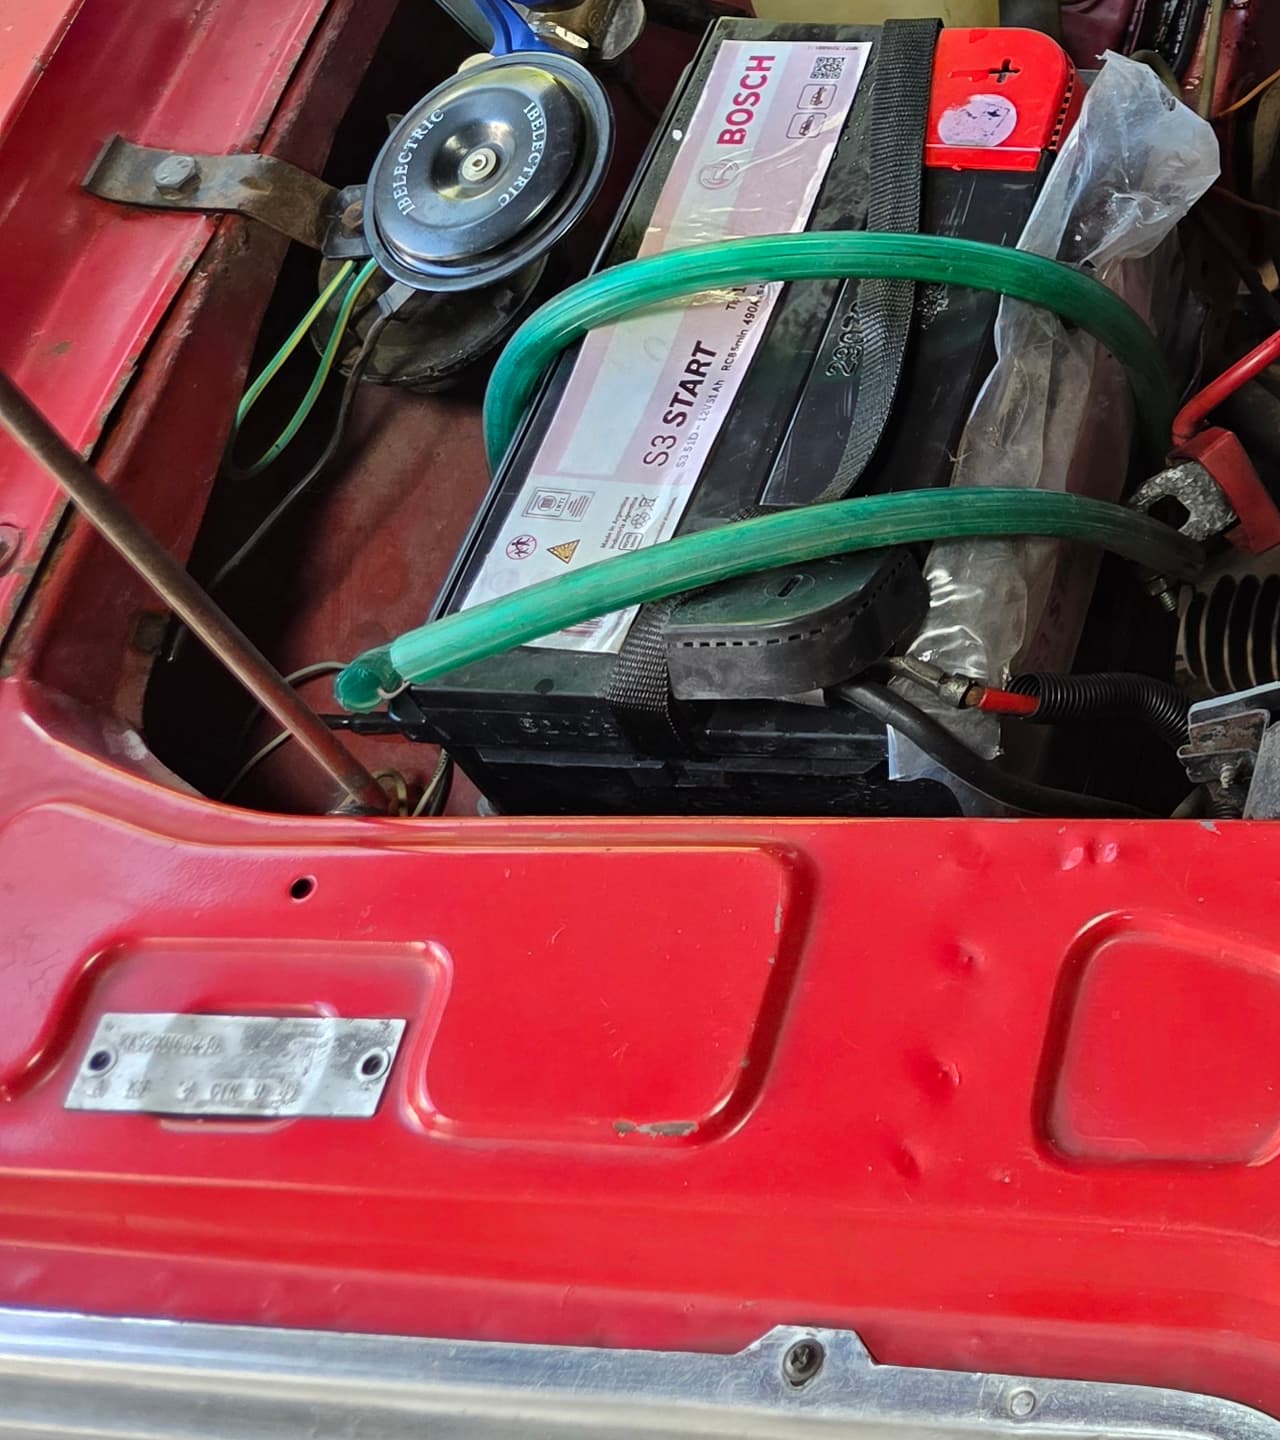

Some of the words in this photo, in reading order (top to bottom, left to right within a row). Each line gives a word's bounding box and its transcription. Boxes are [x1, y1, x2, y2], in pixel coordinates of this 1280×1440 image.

[716, 55, 776, 145] BOSCH
[392, 109, 445, 216] IBELECTRIC
[497, 101, 548, 208] IBELECTRIC
[642, 434, 678, 467] S3
[663, 340, 717, 428] START
